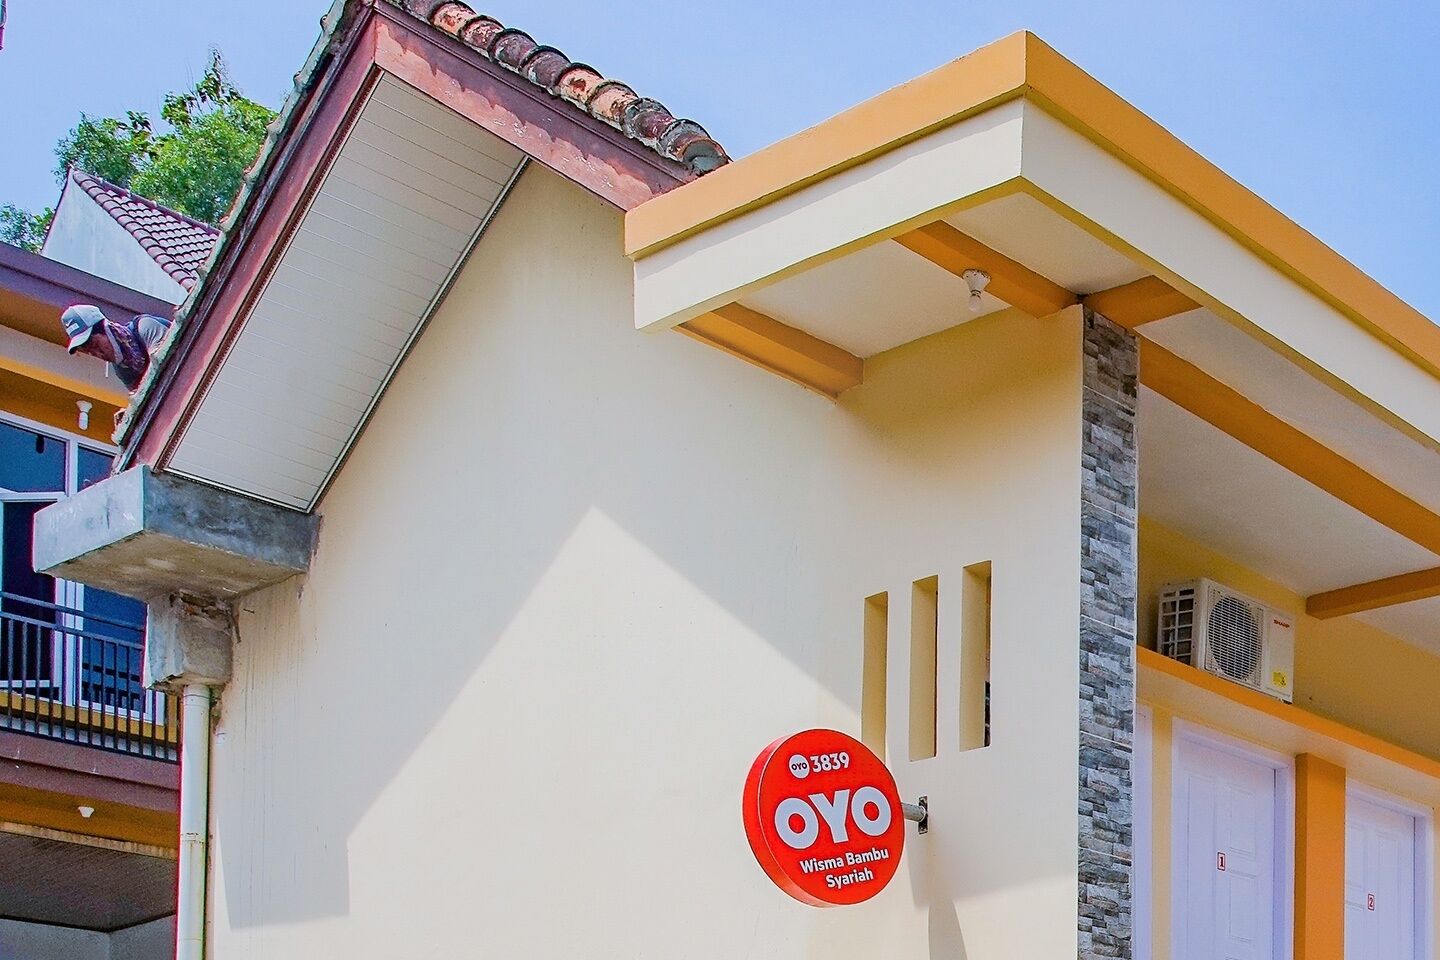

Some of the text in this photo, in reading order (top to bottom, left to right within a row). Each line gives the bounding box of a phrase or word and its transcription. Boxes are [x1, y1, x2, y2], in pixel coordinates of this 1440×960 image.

[791, 751, 850, 773] OYO 3839
[774, 786, 892, 850] OYO
[800, 847, 889, 874] Wisma Bambu
[825, 867, 874, 890] Syariah
